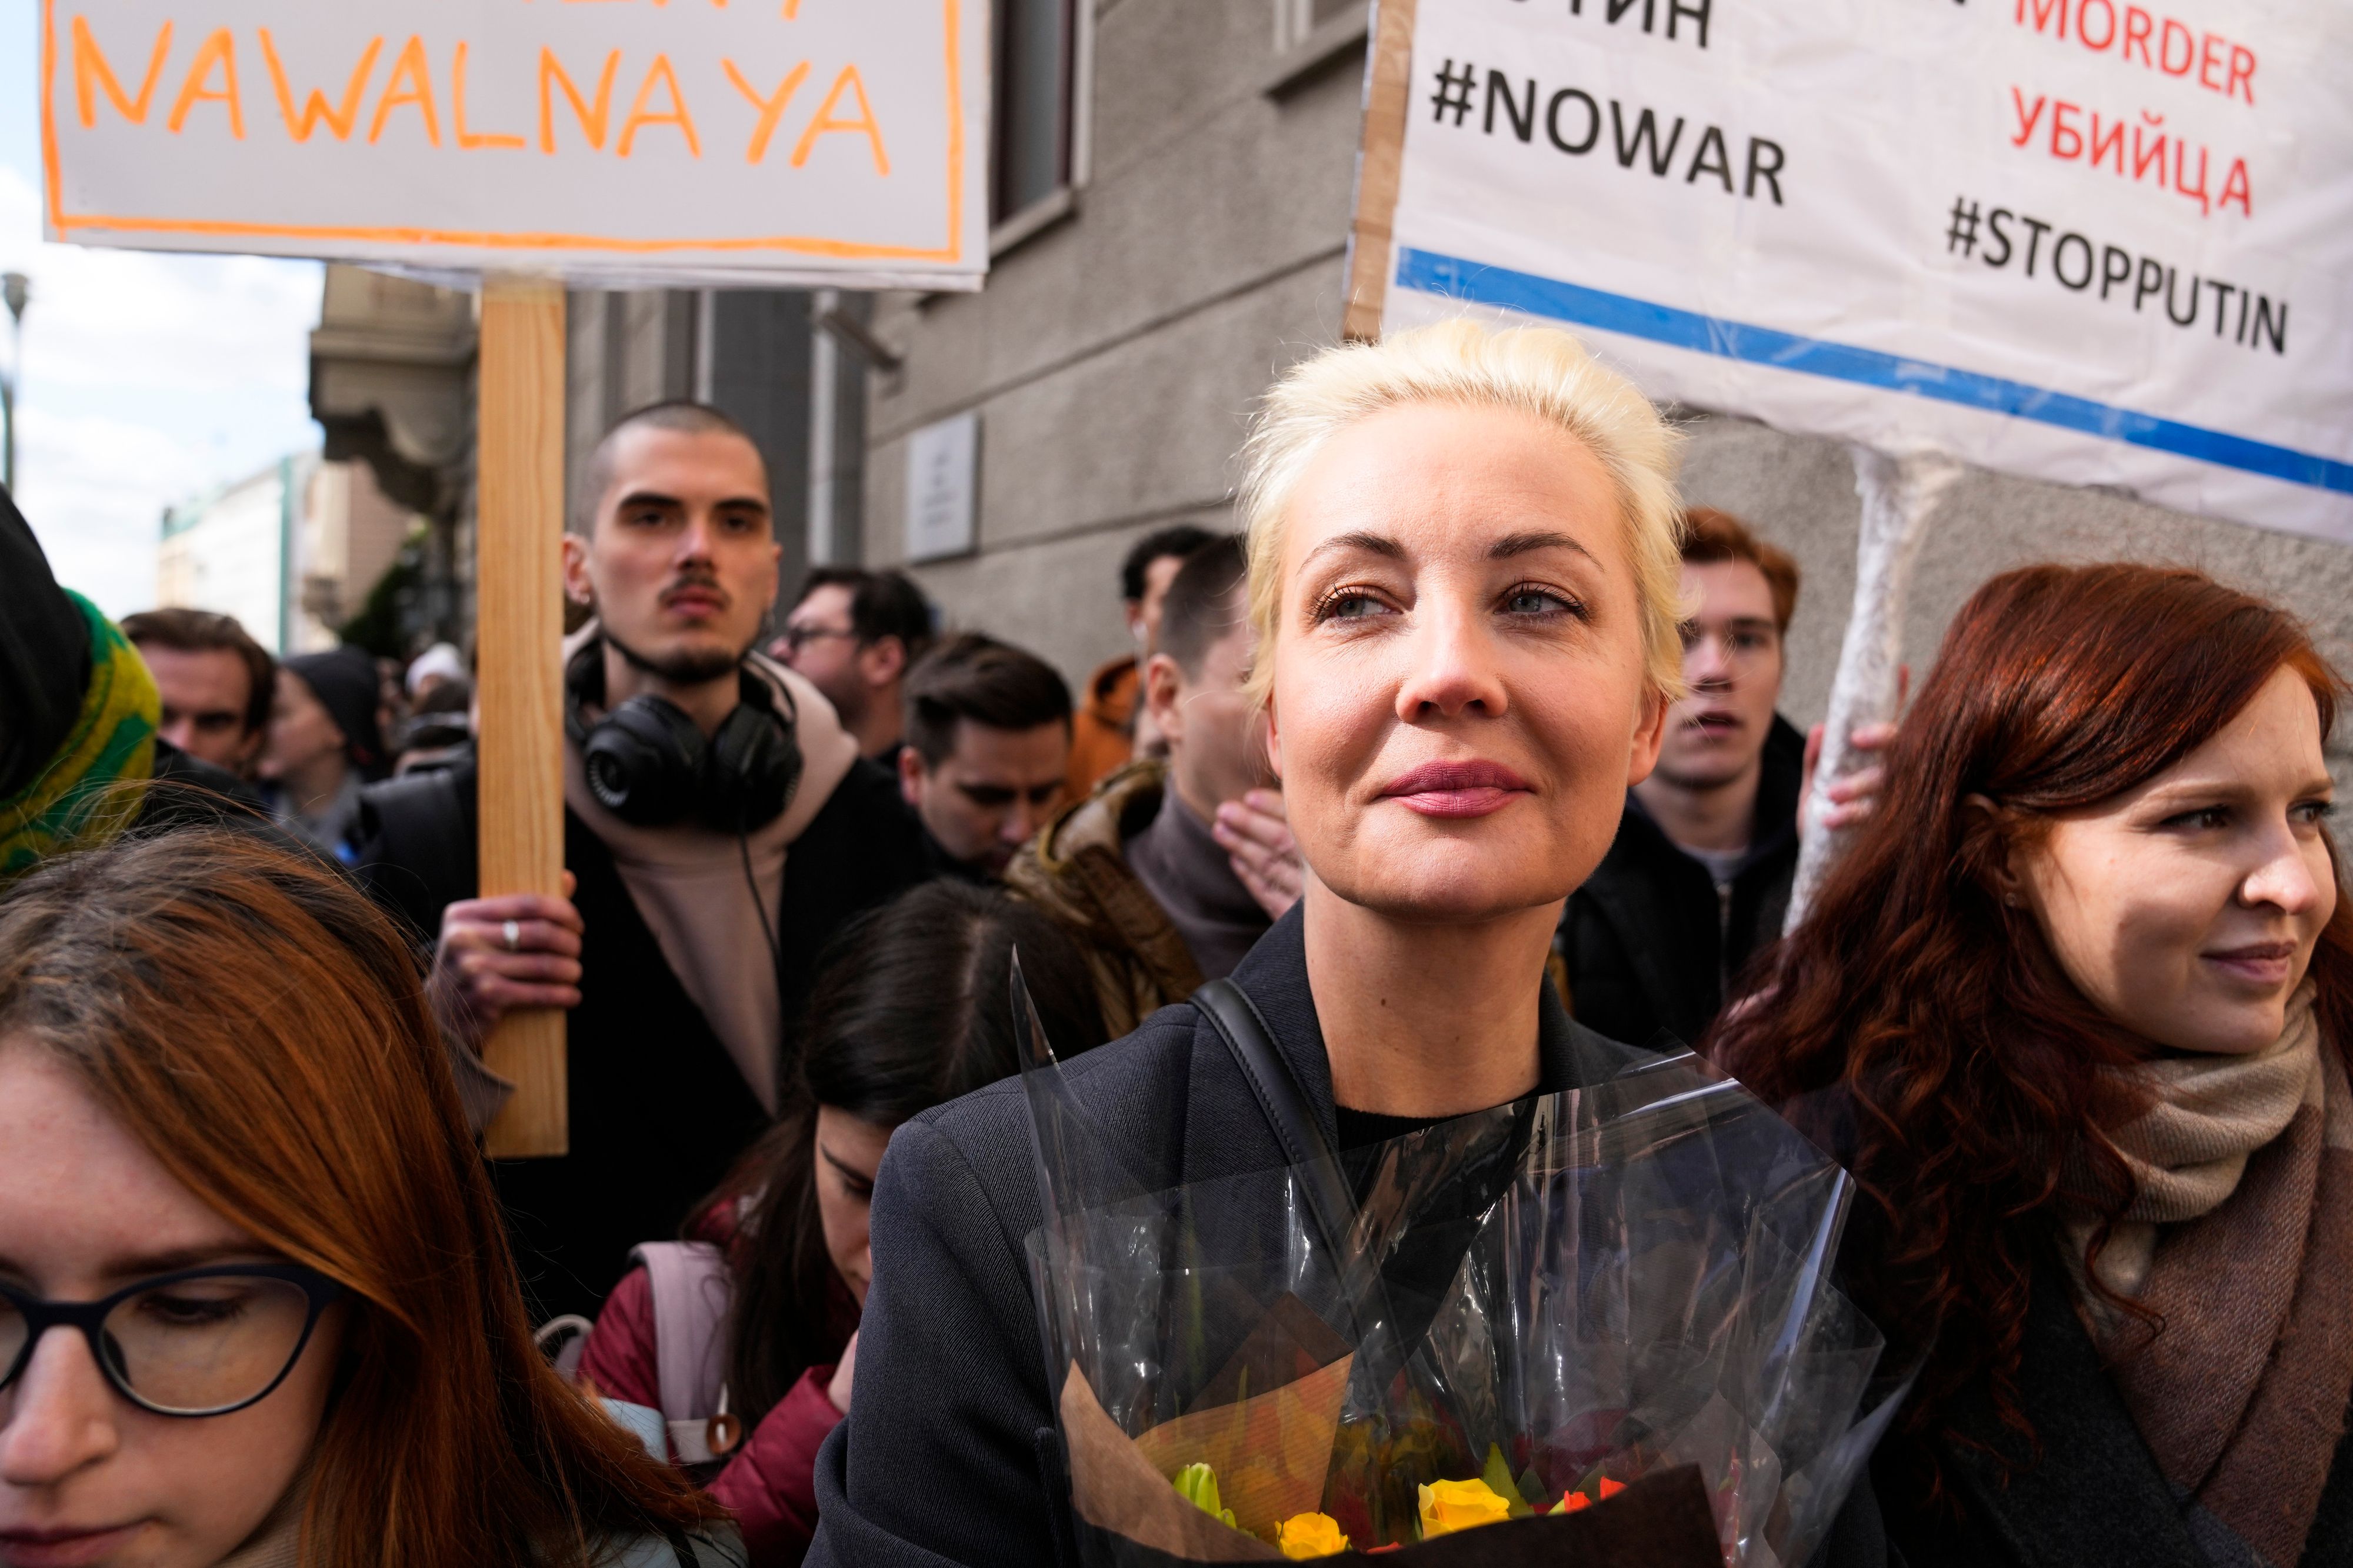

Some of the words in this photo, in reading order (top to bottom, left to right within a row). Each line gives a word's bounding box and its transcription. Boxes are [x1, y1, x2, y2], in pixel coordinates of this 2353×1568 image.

[70, 14, 891, 176] NAWALNAYA
[2014, 0, 2258, 106] MORDER
[1430, 58, 1786, 206] #NOWAR
[2010, 85, 2253, 218] УБИЙЦА
[1947, 196, 2289, 356] #STOPPUTIN
